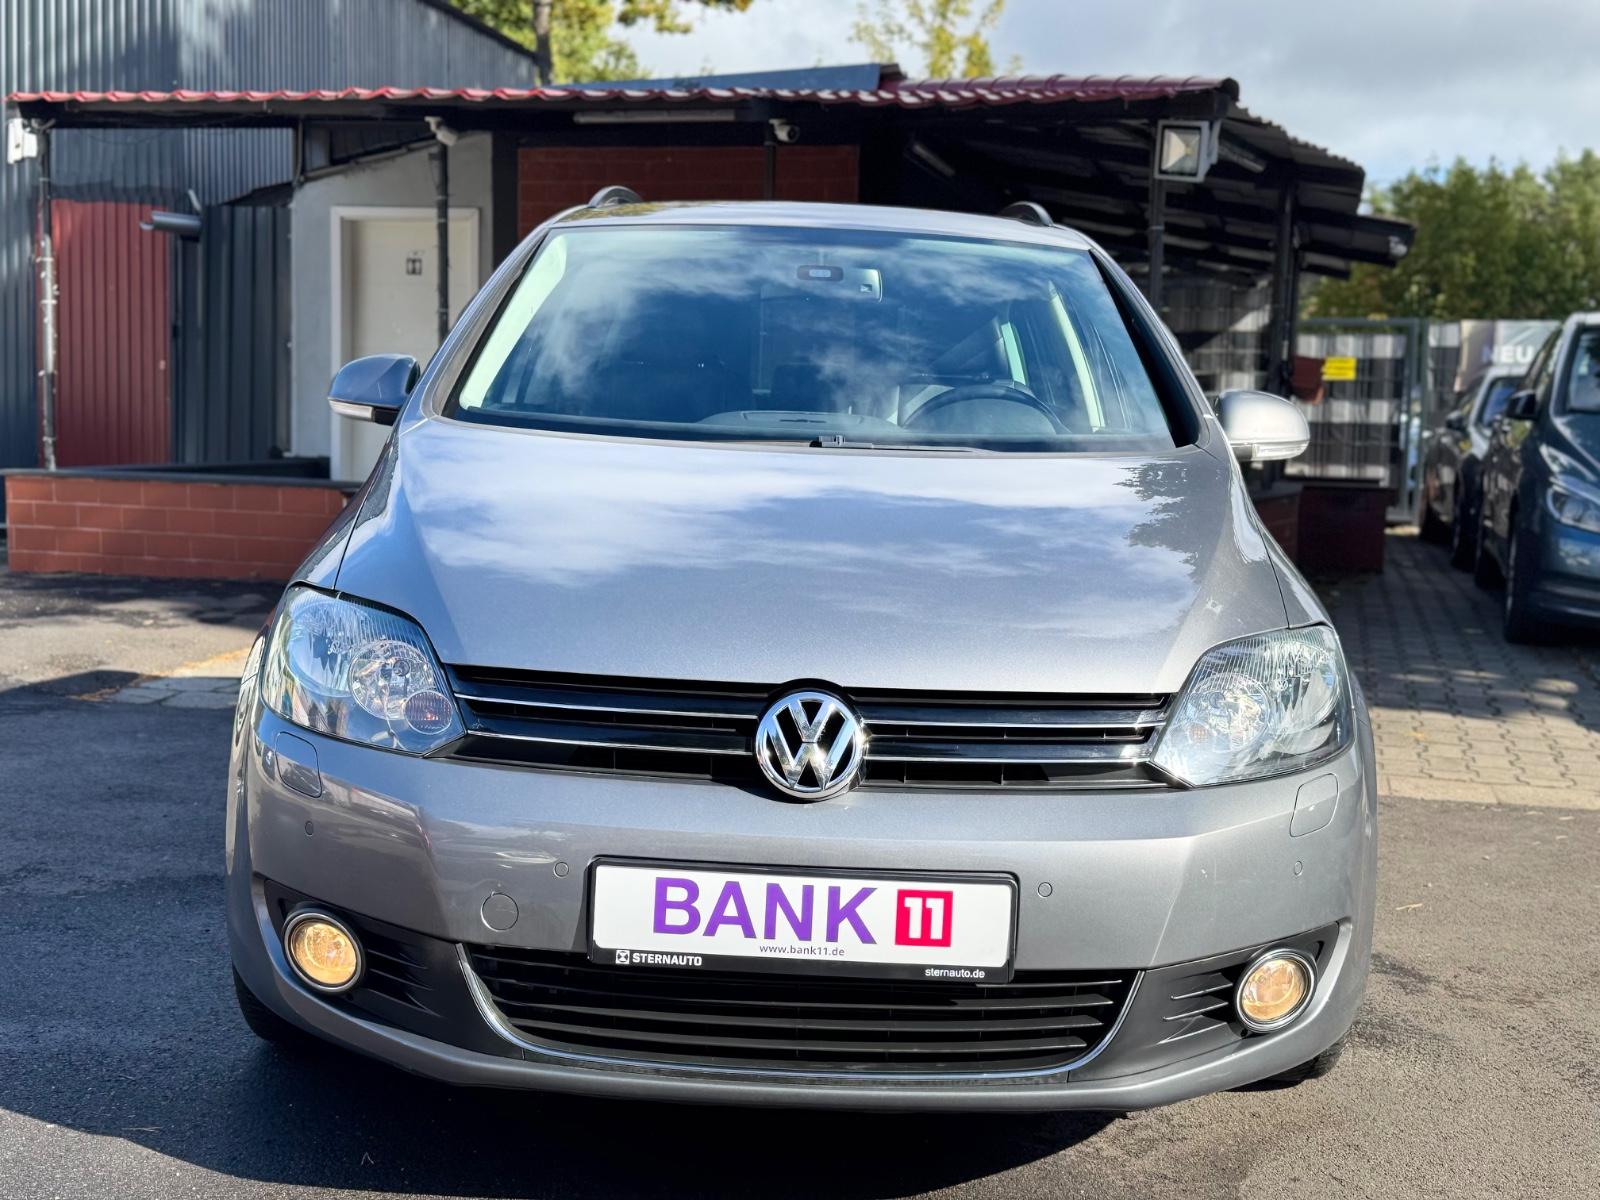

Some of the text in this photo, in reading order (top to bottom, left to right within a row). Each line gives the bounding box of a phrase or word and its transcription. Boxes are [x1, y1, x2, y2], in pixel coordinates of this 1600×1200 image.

[762, 696, 856, 791] VW
[653, 876, 944, 945] BANK 11
[759, 944, 845, 957] www.bank11.de
[632, 952, 702, 966] STERNAUTO
[925, 967, 985, 978] sternauto.de
